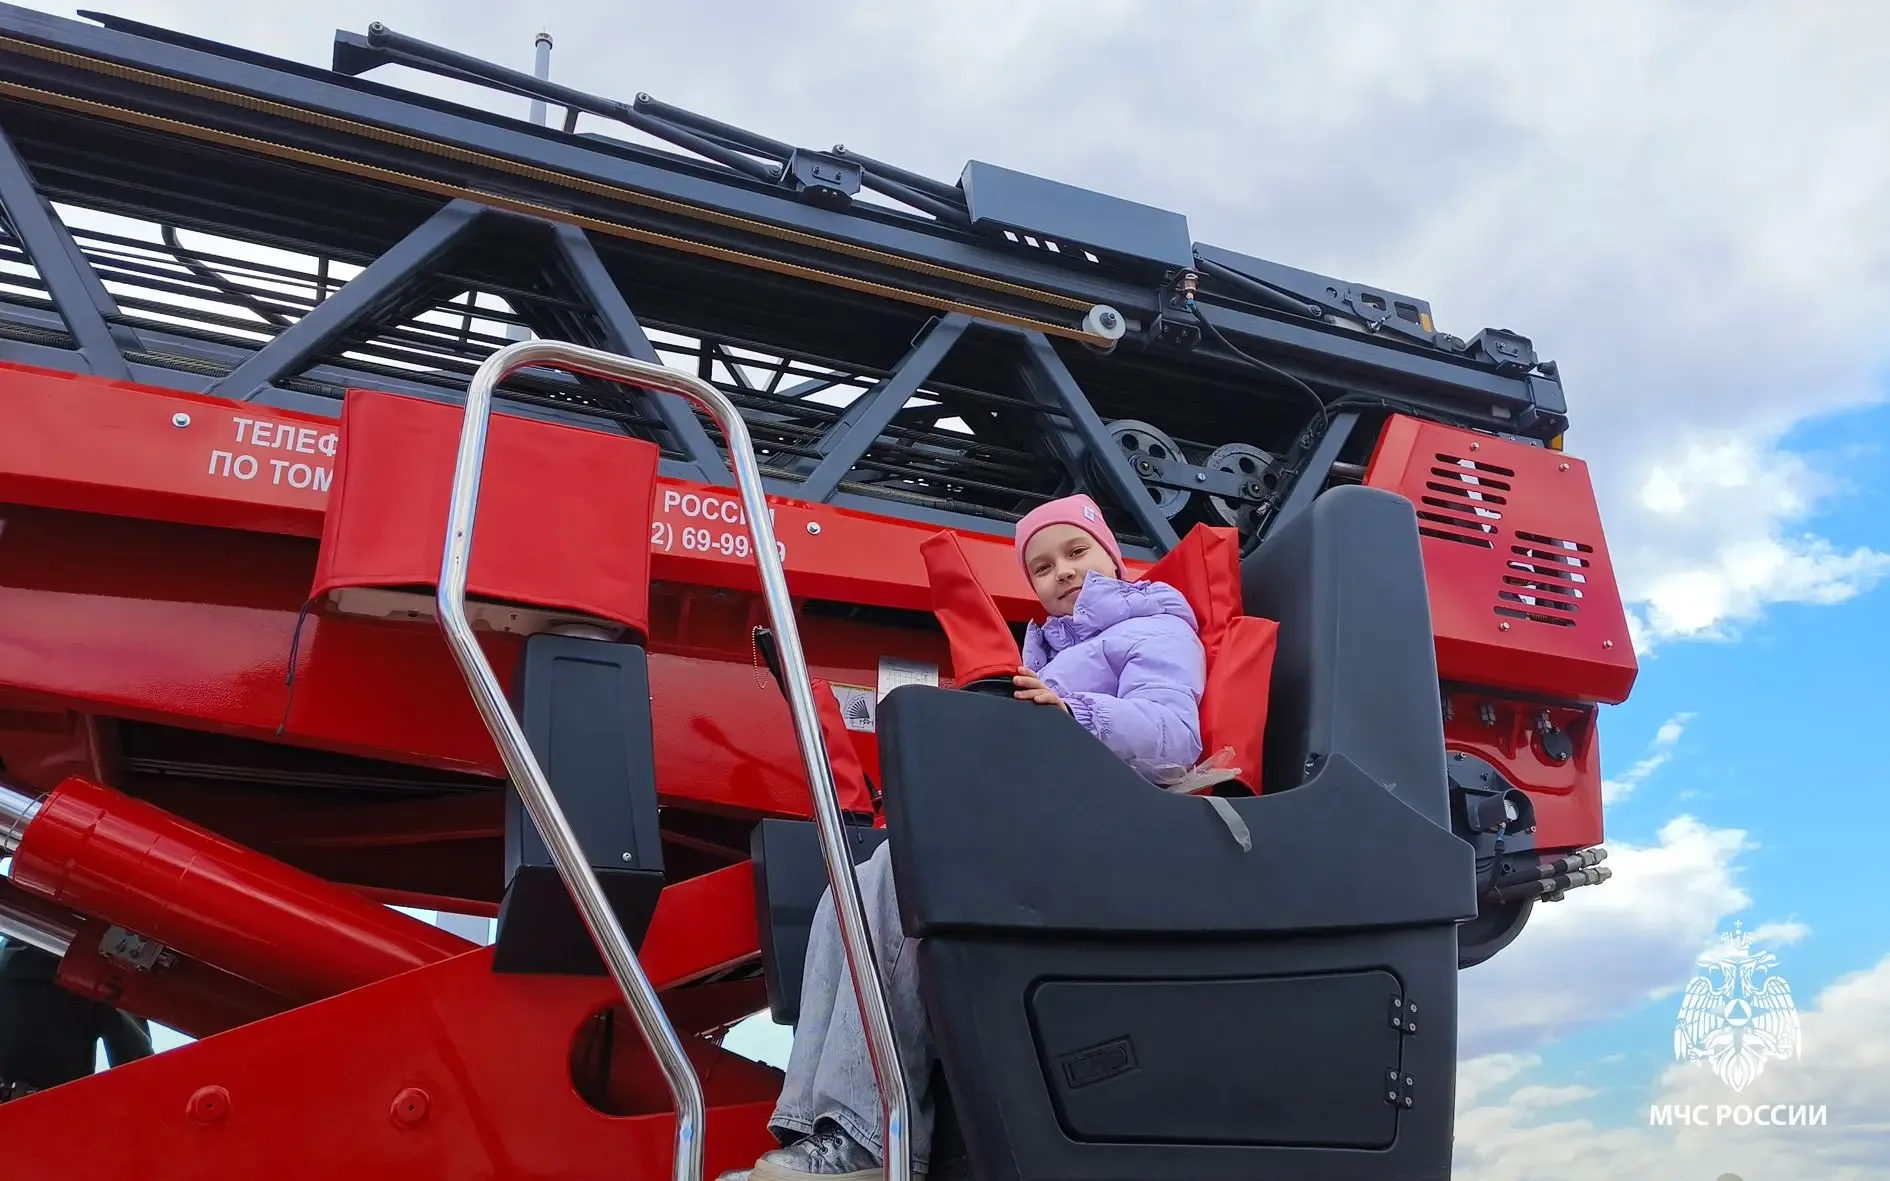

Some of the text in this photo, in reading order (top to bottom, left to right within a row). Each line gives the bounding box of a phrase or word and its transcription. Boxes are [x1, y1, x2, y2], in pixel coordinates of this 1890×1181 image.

[208, 450, 258, 481] ПО
[269, 459, 334, 492] ТОМ
[682, 526, 786, 563] 69-999
[233, 416, 775, 529] ТЕЛЕФ РОСС
